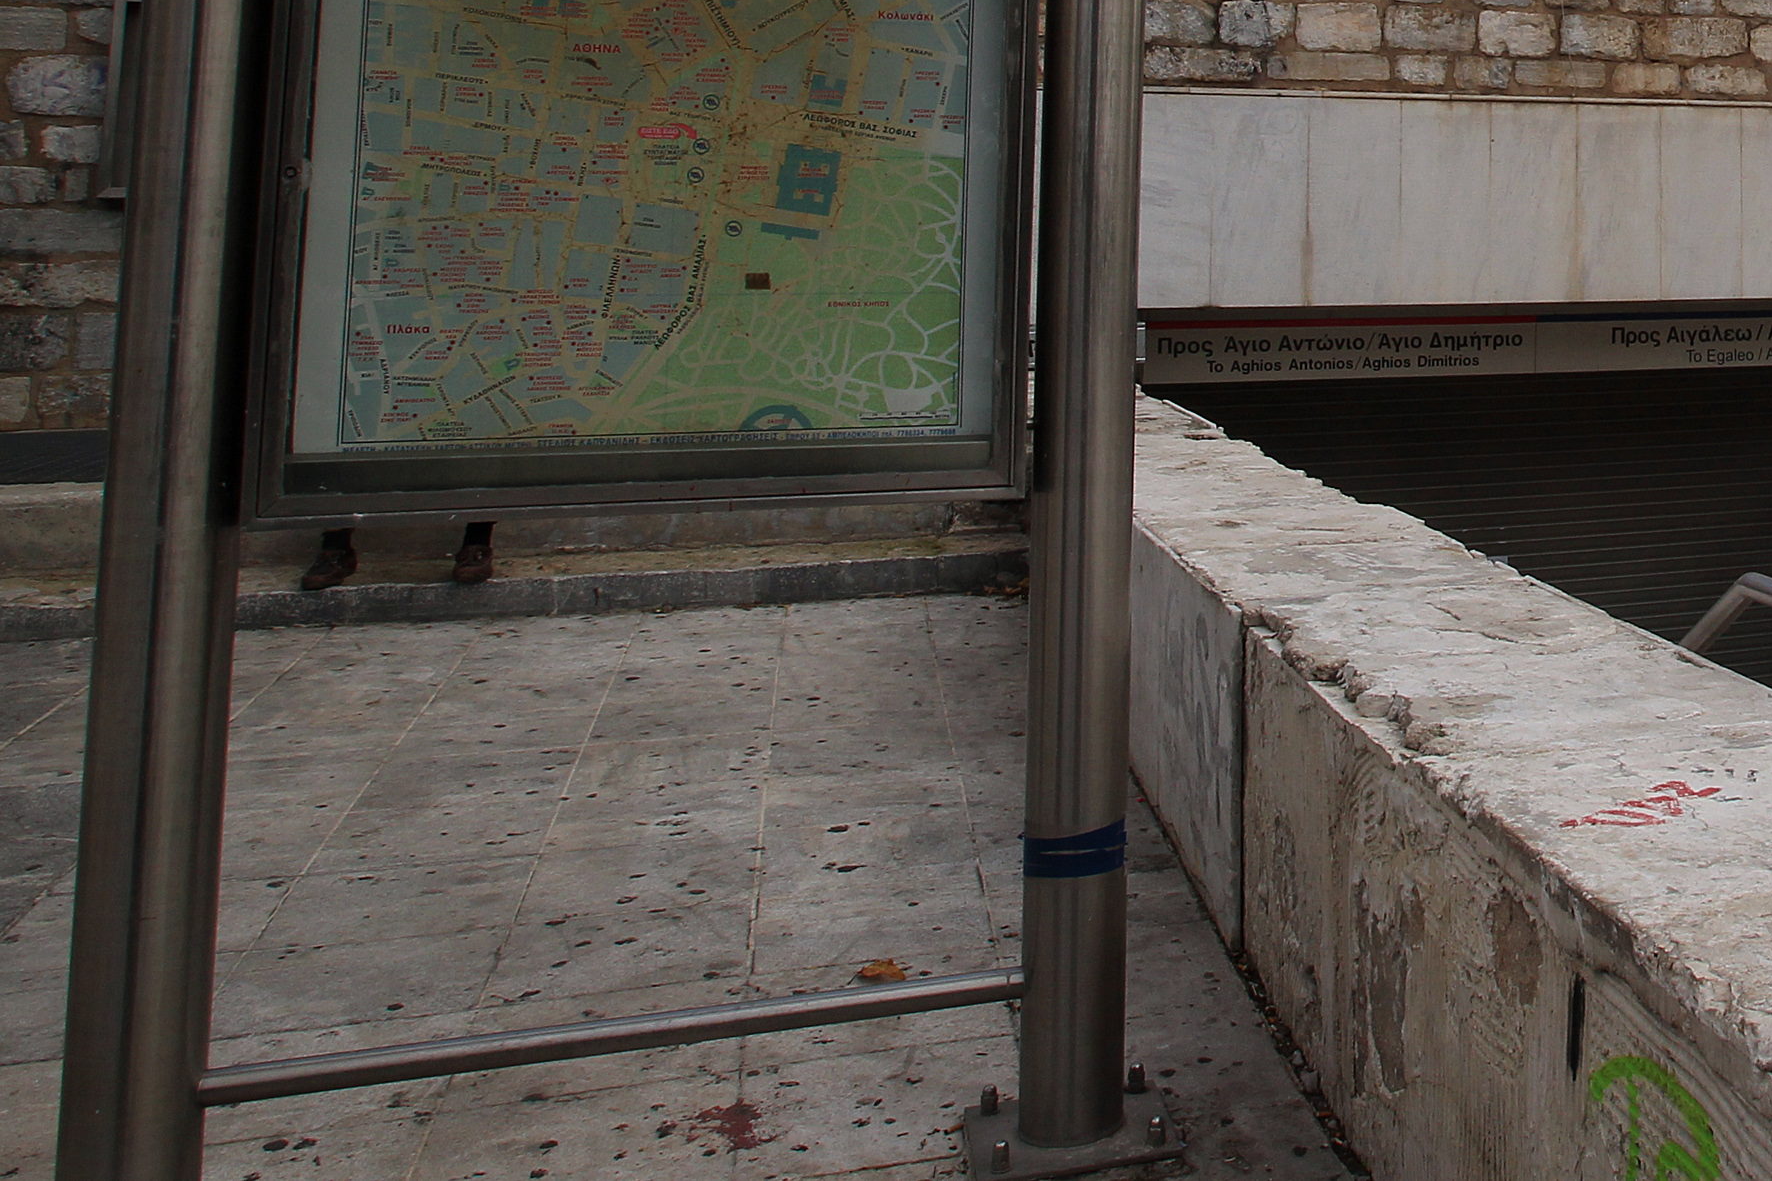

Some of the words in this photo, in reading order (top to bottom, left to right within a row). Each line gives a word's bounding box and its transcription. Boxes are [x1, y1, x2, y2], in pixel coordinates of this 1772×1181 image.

[878, 11, 934, 21] Κολωνάκι
[572, 43, 622, 54] ΑΘΗΝΑ
[435, 72, 484, 84] ΠΕΡΙΚΛΕΟΥΣ
[802, 113, 856, 128] ΛΕΩΦΟΡΟΣ
[883, 126, 917, 138] ΣΟΦΙΑΣ
[420, 163, 482, 177] ΜΗΤΡΟΠΟΛΕΩΣ
[601, 259, 620, 318] ΦΙΛΕΛΛΗΝΩΝ
[654, 305, 691, 350] ΛΕΩΦΟΡΟΣ
[692, 239, 706, 279] ΑΜΑΛΙΑΣ
[387, 324, 430, 334] Πλάκα
[1611, 326, 1661, 347] Προς
[1666, 324, 1752, 346] Αιγάλεω
[1157, 336, 1214, 356] Προς
[1223, 333, 1271, 355] Άγιο
[1277, 331, 1423, 354] Αντώνιο/Άγιο
[1429, 330, 1524, 350] Δημήτριο
[1206, 359, 1225, 373] To
[1230, 358, 1282, 375] Aghios
[1288, 354, 1412, 372] Antonios/Aghios
[1416, 353, 1480, 368] Dimitrios
[1686, 349, 1703, 363] To
[1706, 347, 1756, 366] Egaleo
